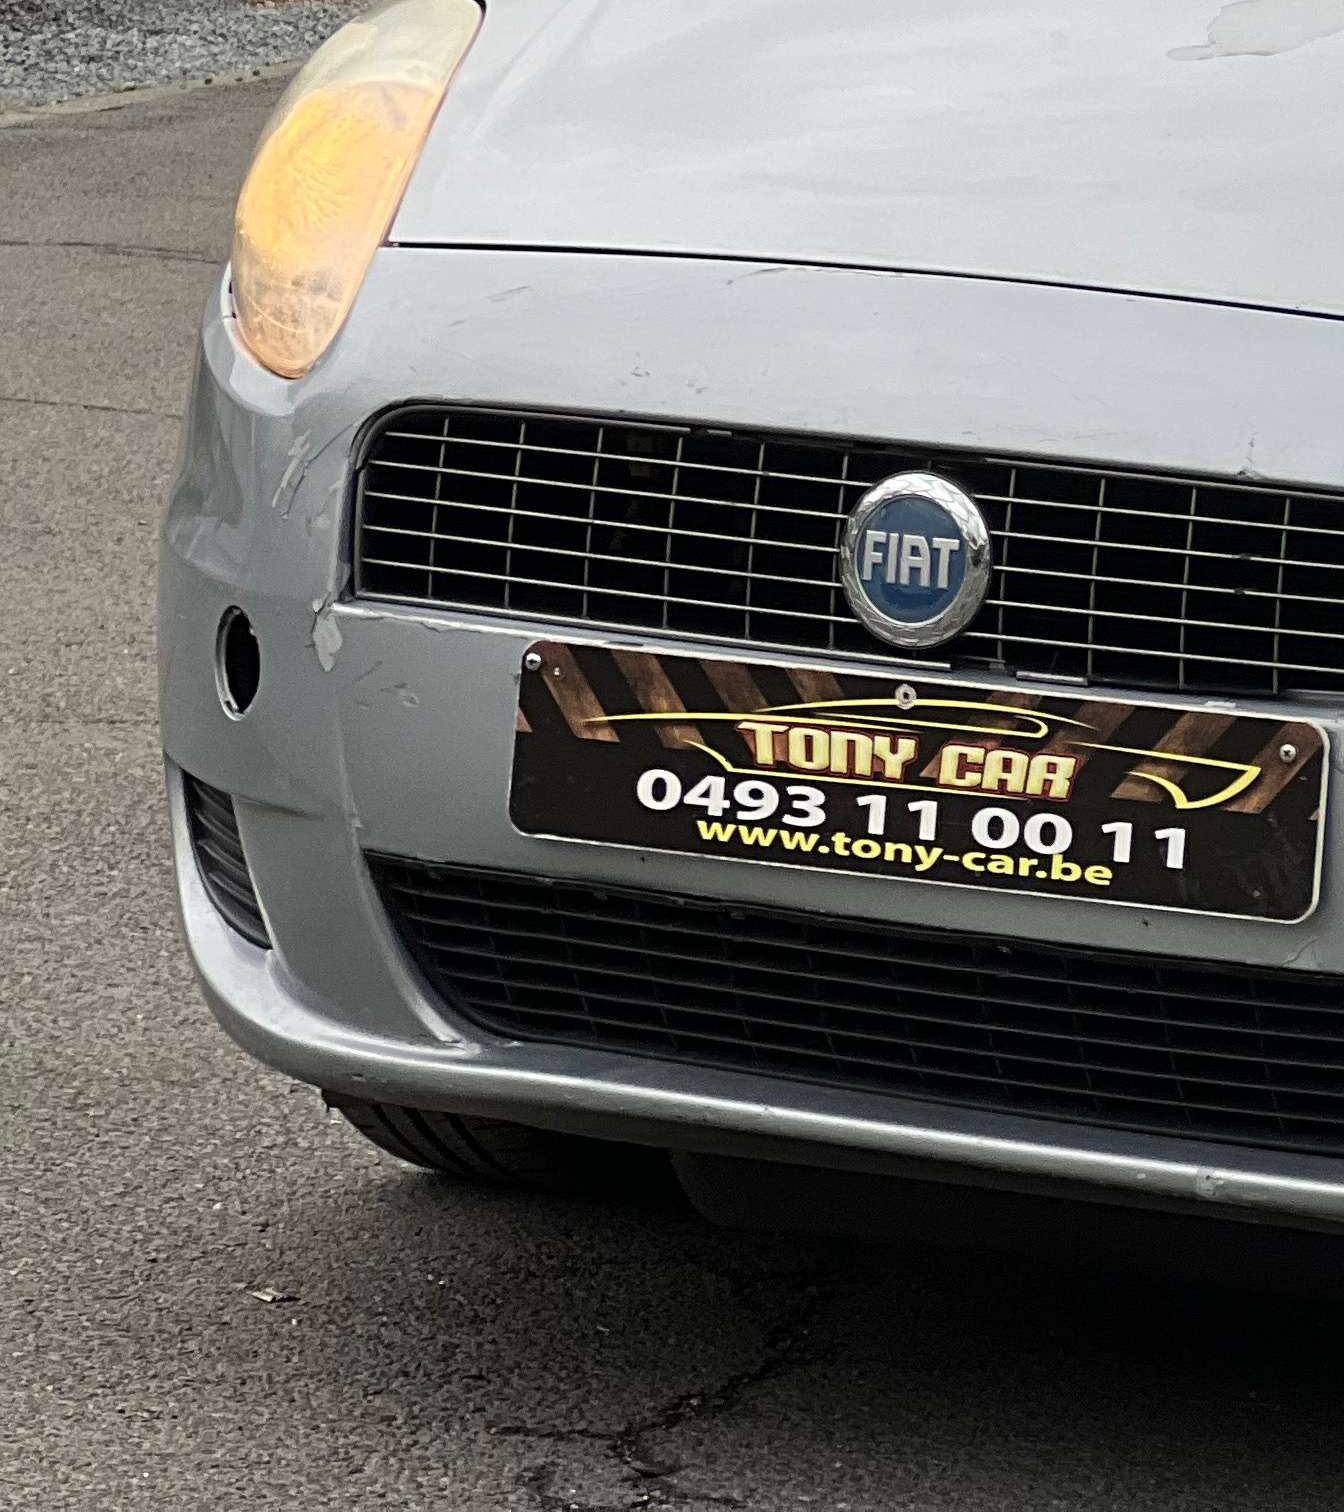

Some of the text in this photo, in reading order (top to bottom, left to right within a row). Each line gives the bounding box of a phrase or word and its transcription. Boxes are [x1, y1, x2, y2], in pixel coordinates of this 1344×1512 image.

[862, 529, 960, 588] FIAT
[736, 721, 1077, 800] TONY CAR
[636, 768, 1187, 869] 0493 11 00 11
[696, 819, 1113, 886] www.tony-car.be
